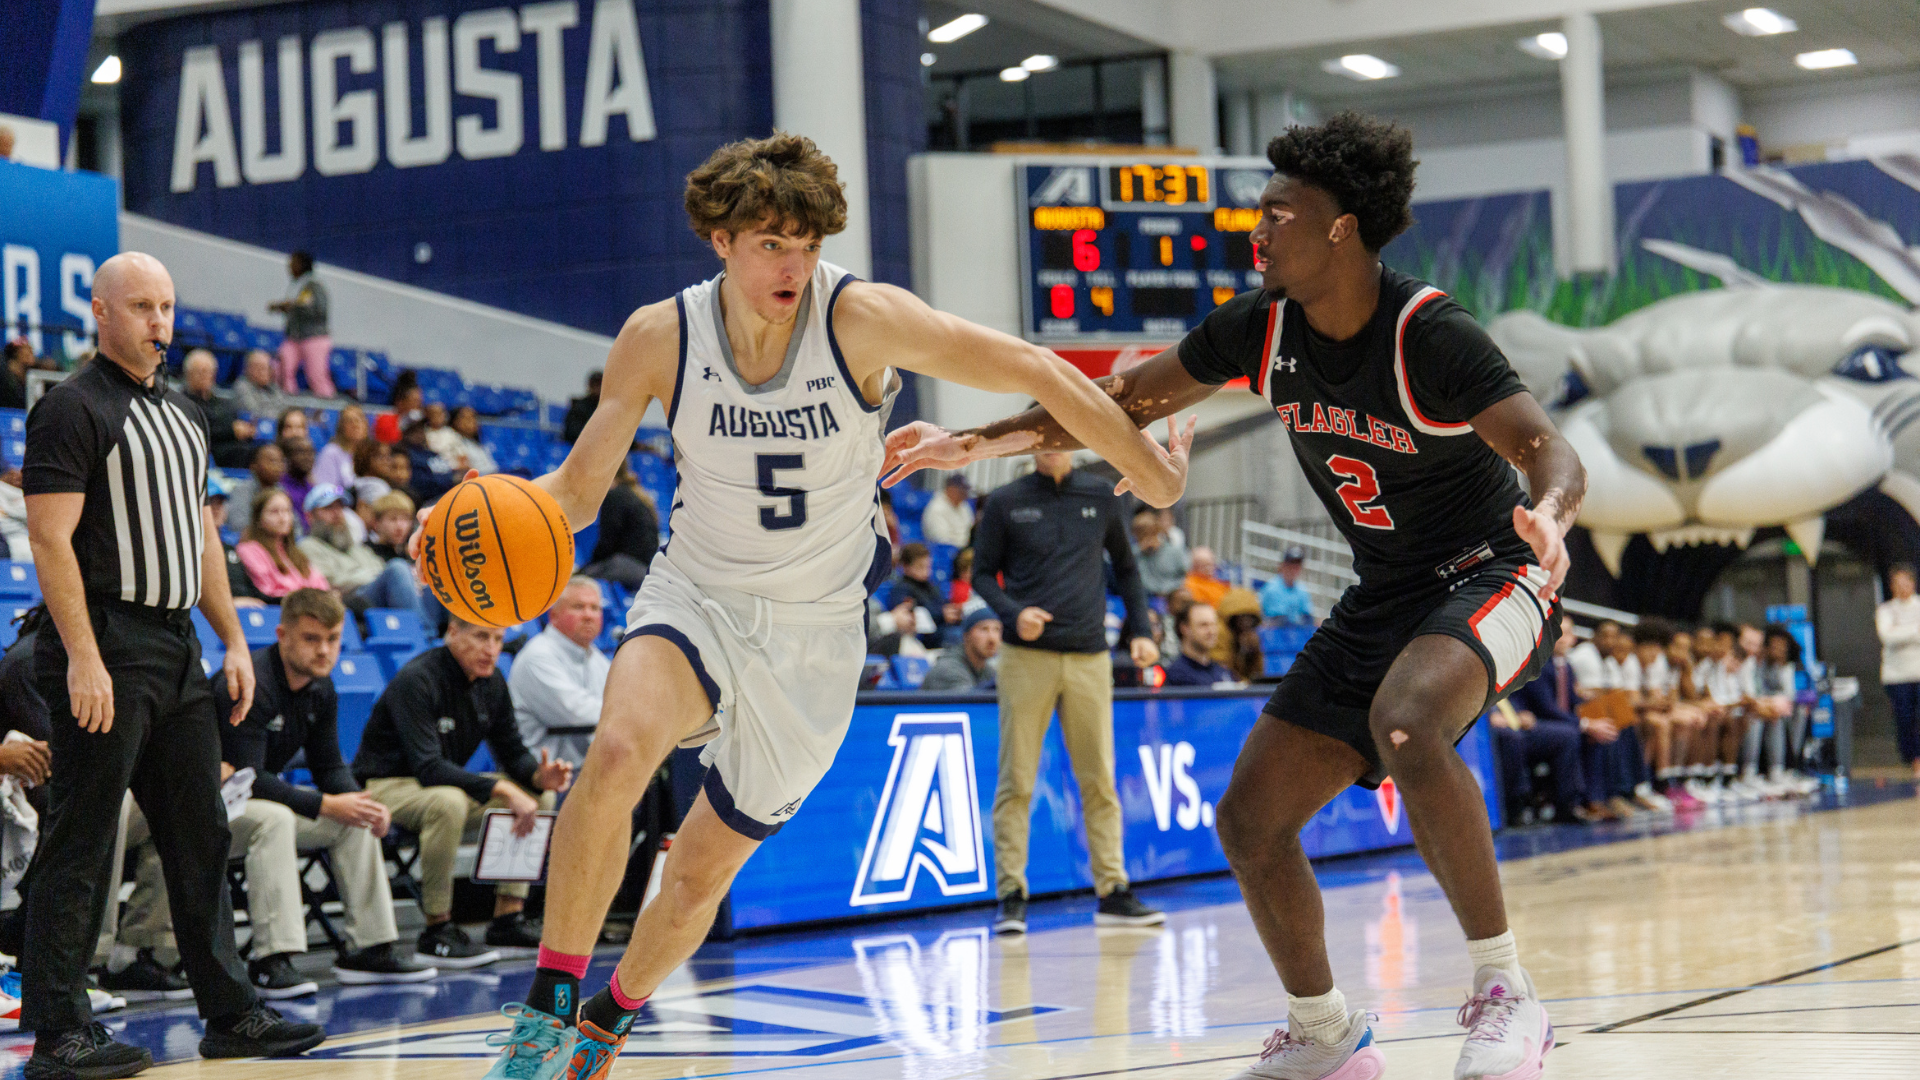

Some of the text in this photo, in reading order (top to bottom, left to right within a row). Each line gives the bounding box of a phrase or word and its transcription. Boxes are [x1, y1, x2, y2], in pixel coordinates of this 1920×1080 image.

[170, 0, 657, 194] AUGUSTA
[1119, 164, 1210, 205] 17:37
[1072, 229, 1101, 272] 6
[1159, 235, 1173, 266] 1
[806, 376, 836, 392] PBC
[708, 401, 840, 440] AUGUSTA
[1276, 402, 1418, 453] FLAGLER
[754, 452, 809, 532] 5
[1325, 454, 1395, 530] 2
[425, 535, 453, 604] NCAA
[454, 509, 495, 610] Wilson
[1138, 741, 1213, 831] VS.
